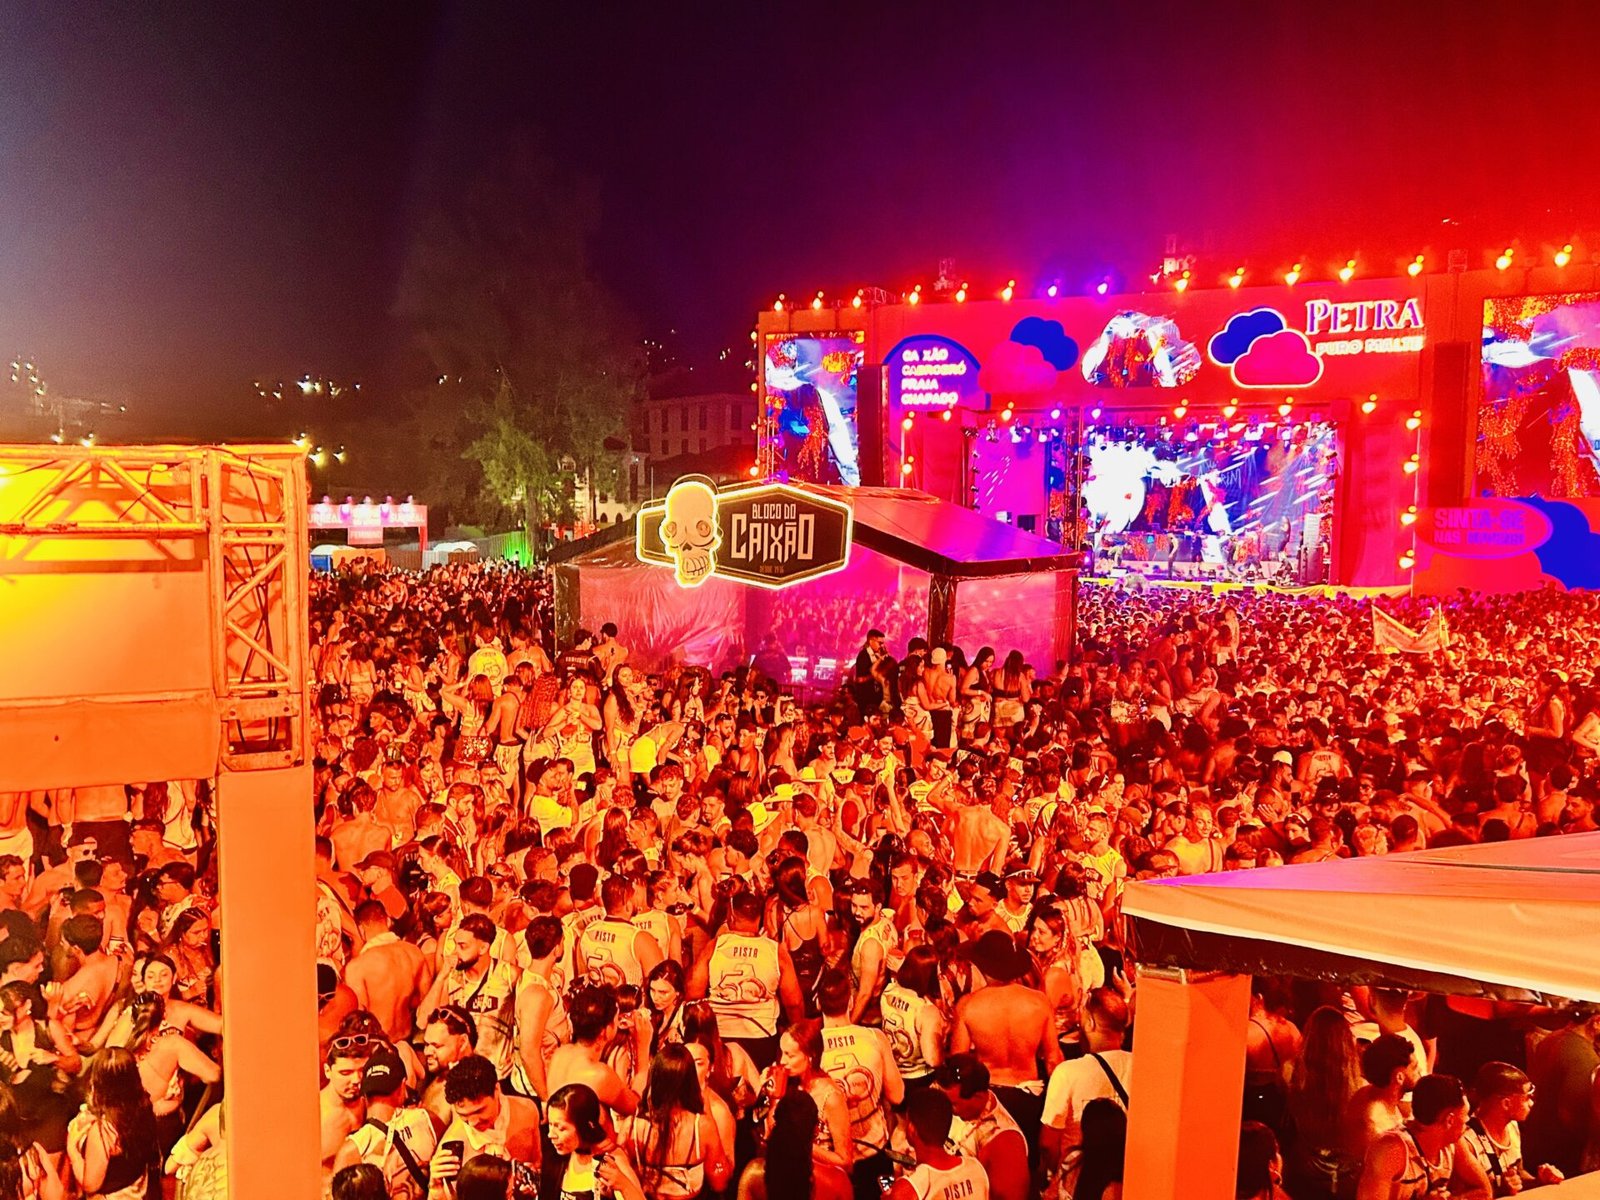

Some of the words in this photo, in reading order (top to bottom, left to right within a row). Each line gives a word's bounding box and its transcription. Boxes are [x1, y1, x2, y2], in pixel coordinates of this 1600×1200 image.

[1305, 298, 1424, 335] PETRA
[1316, 339, 1363, 356] PURO
[752, 503, 782, 519] BLOCO
[784, 503, 797, 519] DO
[731, 513, 815, 563] CAIXÃO
[732, 946, 759, 959] PISTA
[827, 1035, 856, 1049] PISTA
[944, 1179, 973, 1200] PISTA
